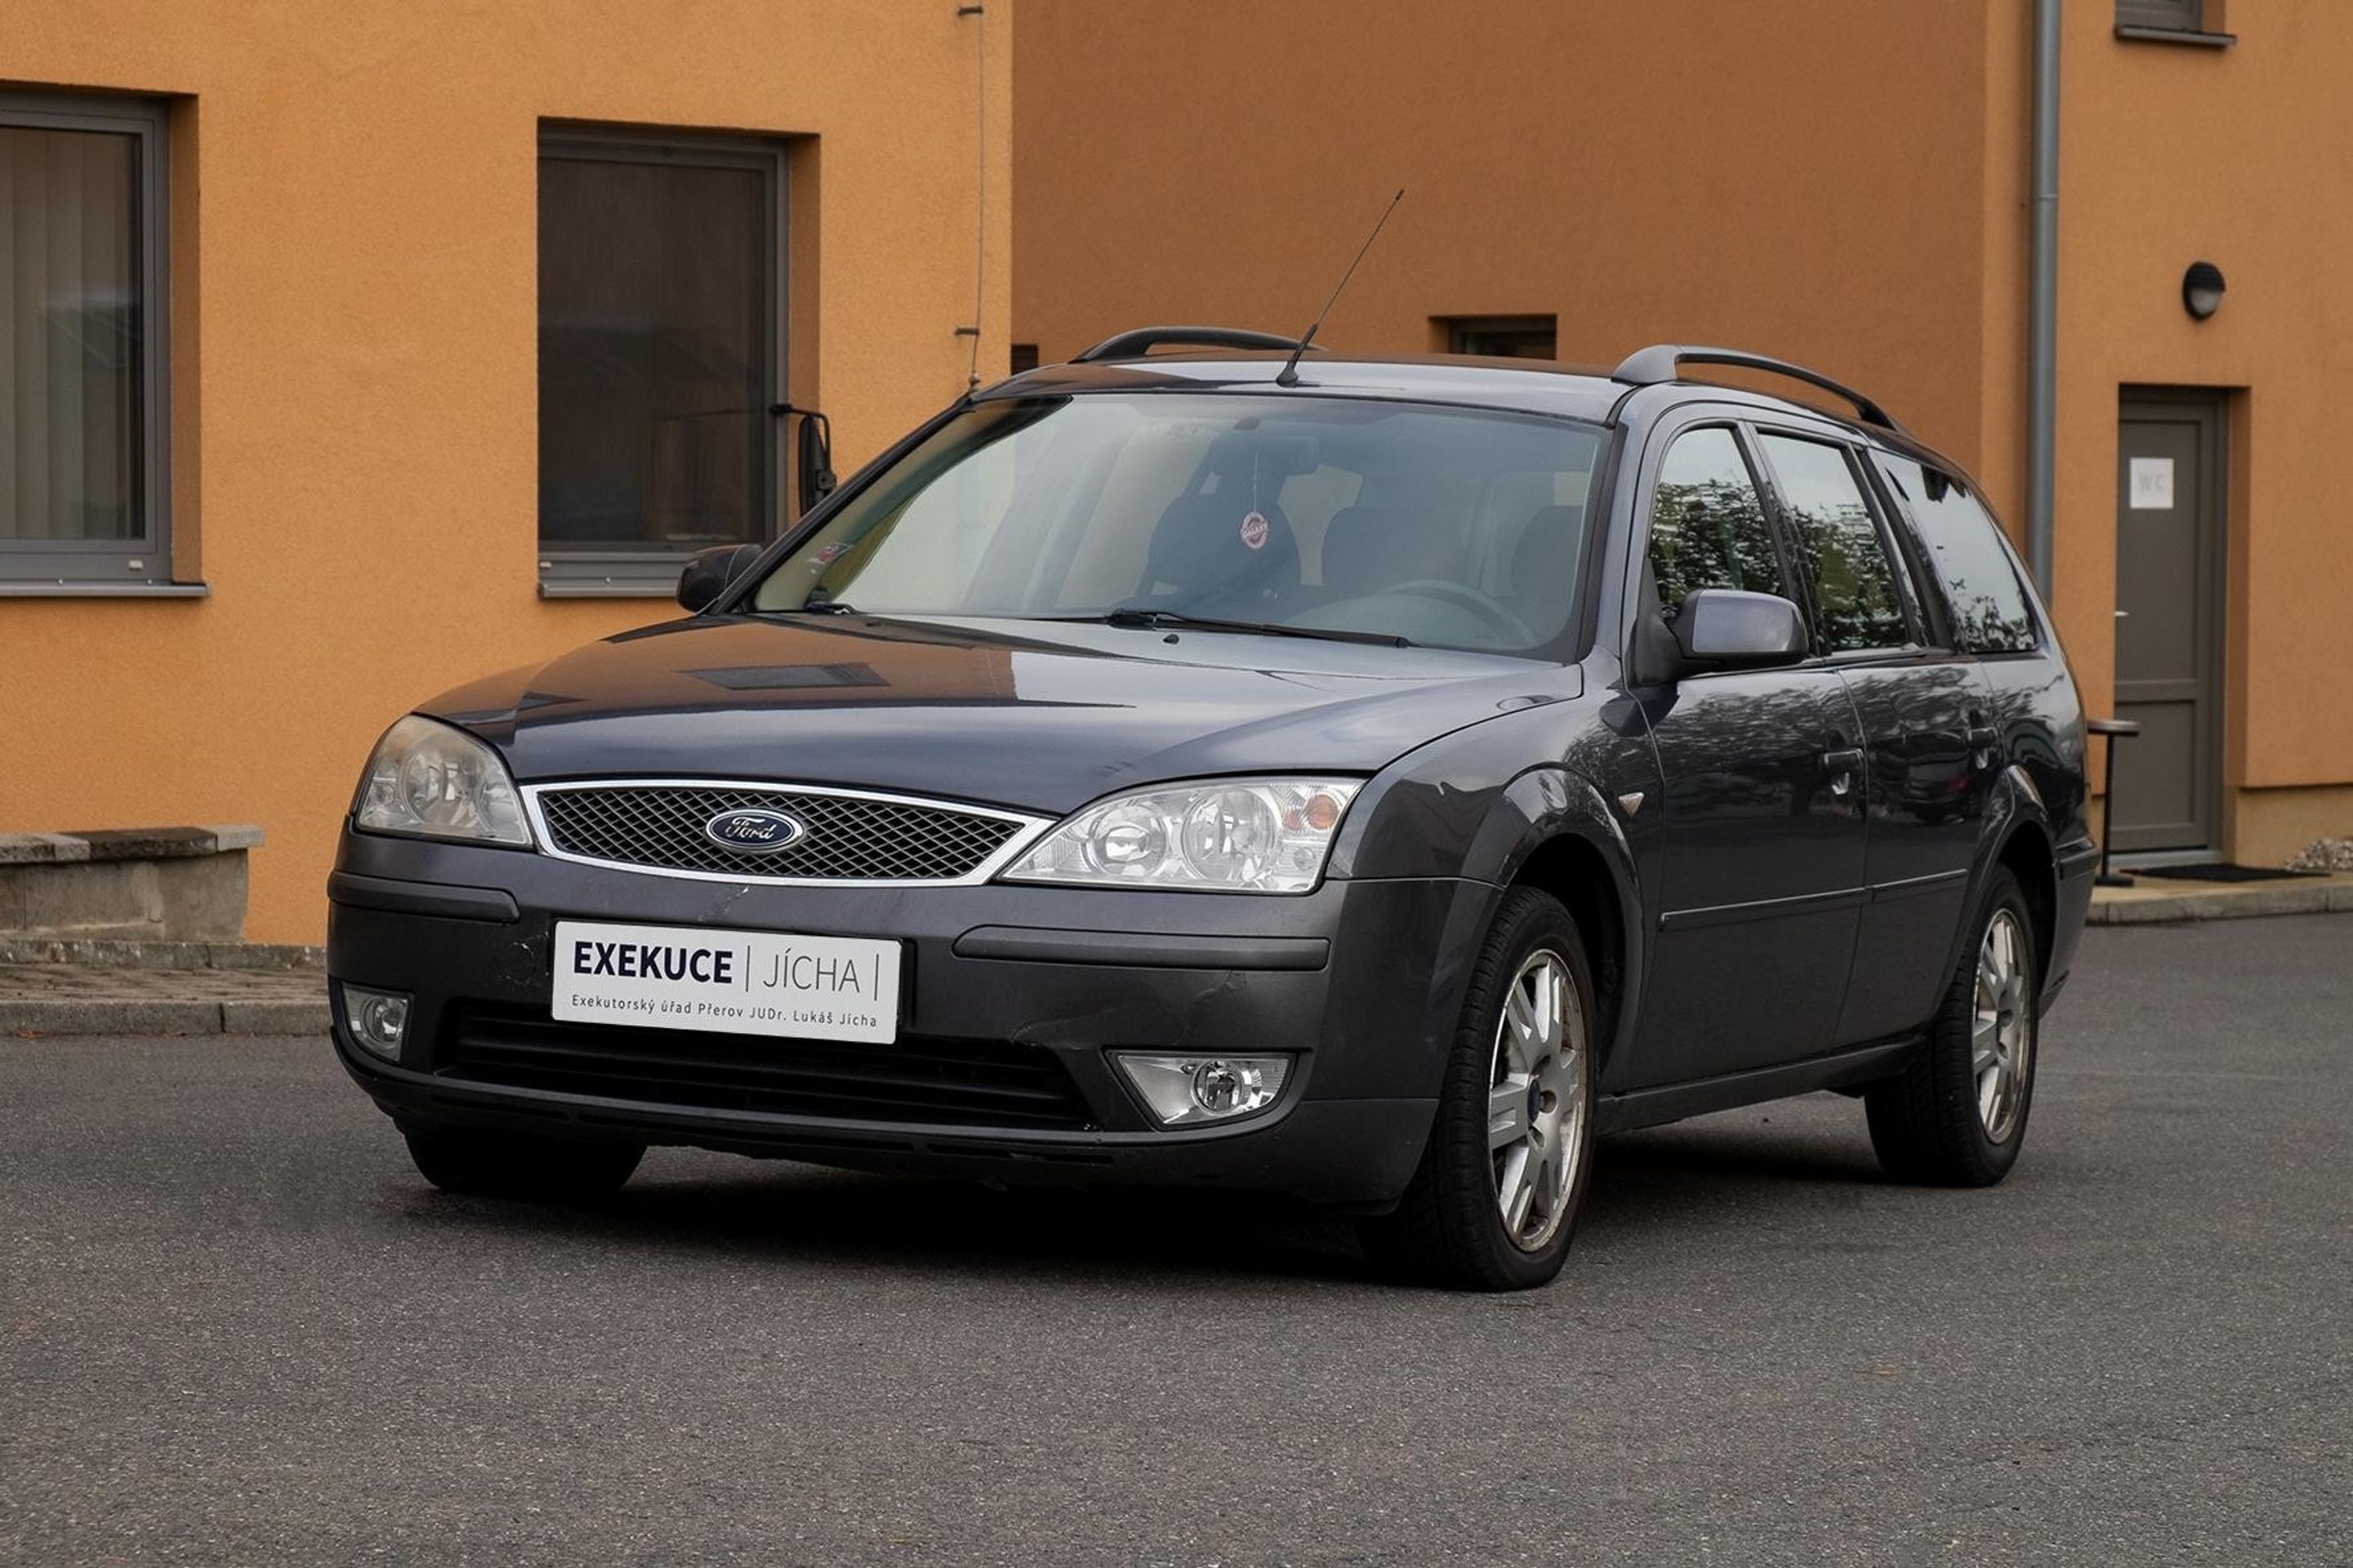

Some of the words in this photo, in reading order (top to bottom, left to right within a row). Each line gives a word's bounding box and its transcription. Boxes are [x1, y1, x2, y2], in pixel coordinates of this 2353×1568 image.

[724, 817, 777, 839] Ford
[573, 941, 733, 984] EXEKUCE
[763, 947, 860, 993] JÍCHA
[572, 994, 655, 1014] Exekutorský
[661, 1000, 691, 1013] úřad
[698, 1001, 743, 1017] Přerov
[750, 1008, 787, 1021] JUDr.
[794, 1010, 833, 1024] Lukáš
[840, 1013, 876, 1027] Jícha
